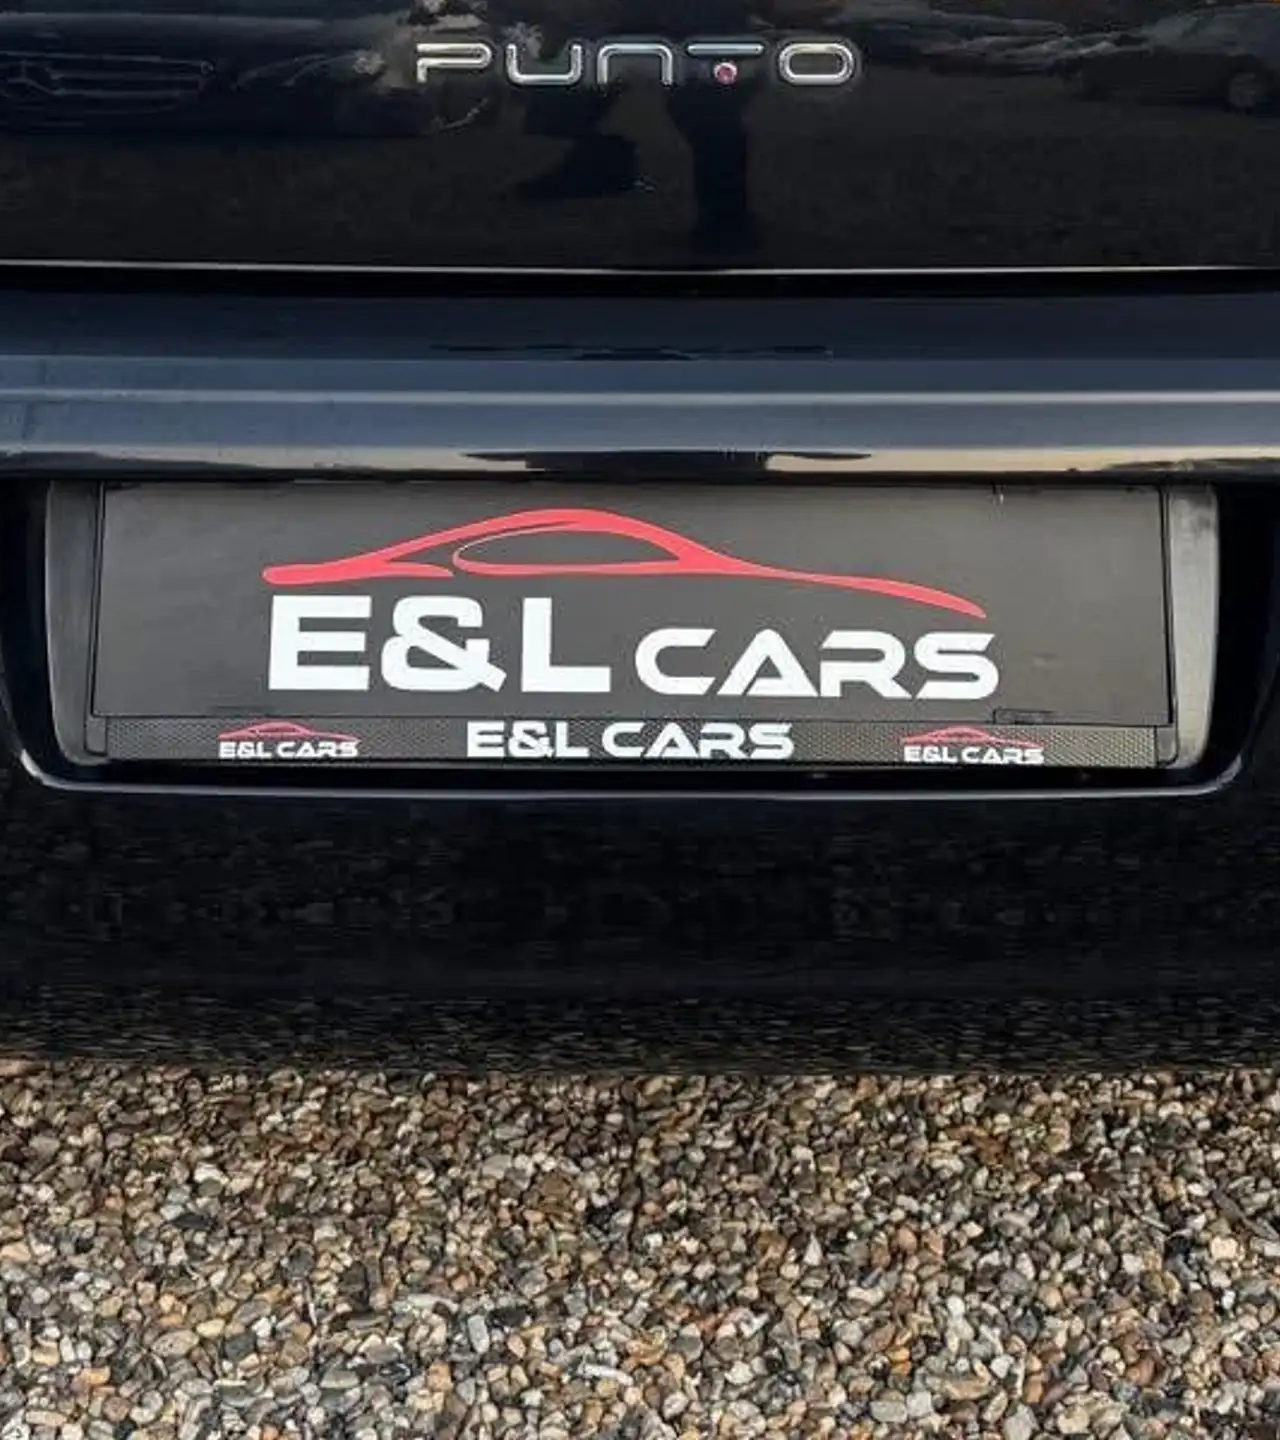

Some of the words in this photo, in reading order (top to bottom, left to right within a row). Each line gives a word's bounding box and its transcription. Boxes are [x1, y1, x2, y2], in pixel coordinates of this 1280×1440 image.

[268, 594, 612, 694] E&L
[635, 627, 1000, 701] CARS
[219, 741, 271, 758] E&L
[276, 741, 358, 758] CARS
[467, 720, 589, 758] E&L
[601, 721, 795, 759] CARS
[904, 746, 957, 763] E&L
[961, 747, 1045, 764] CARS
